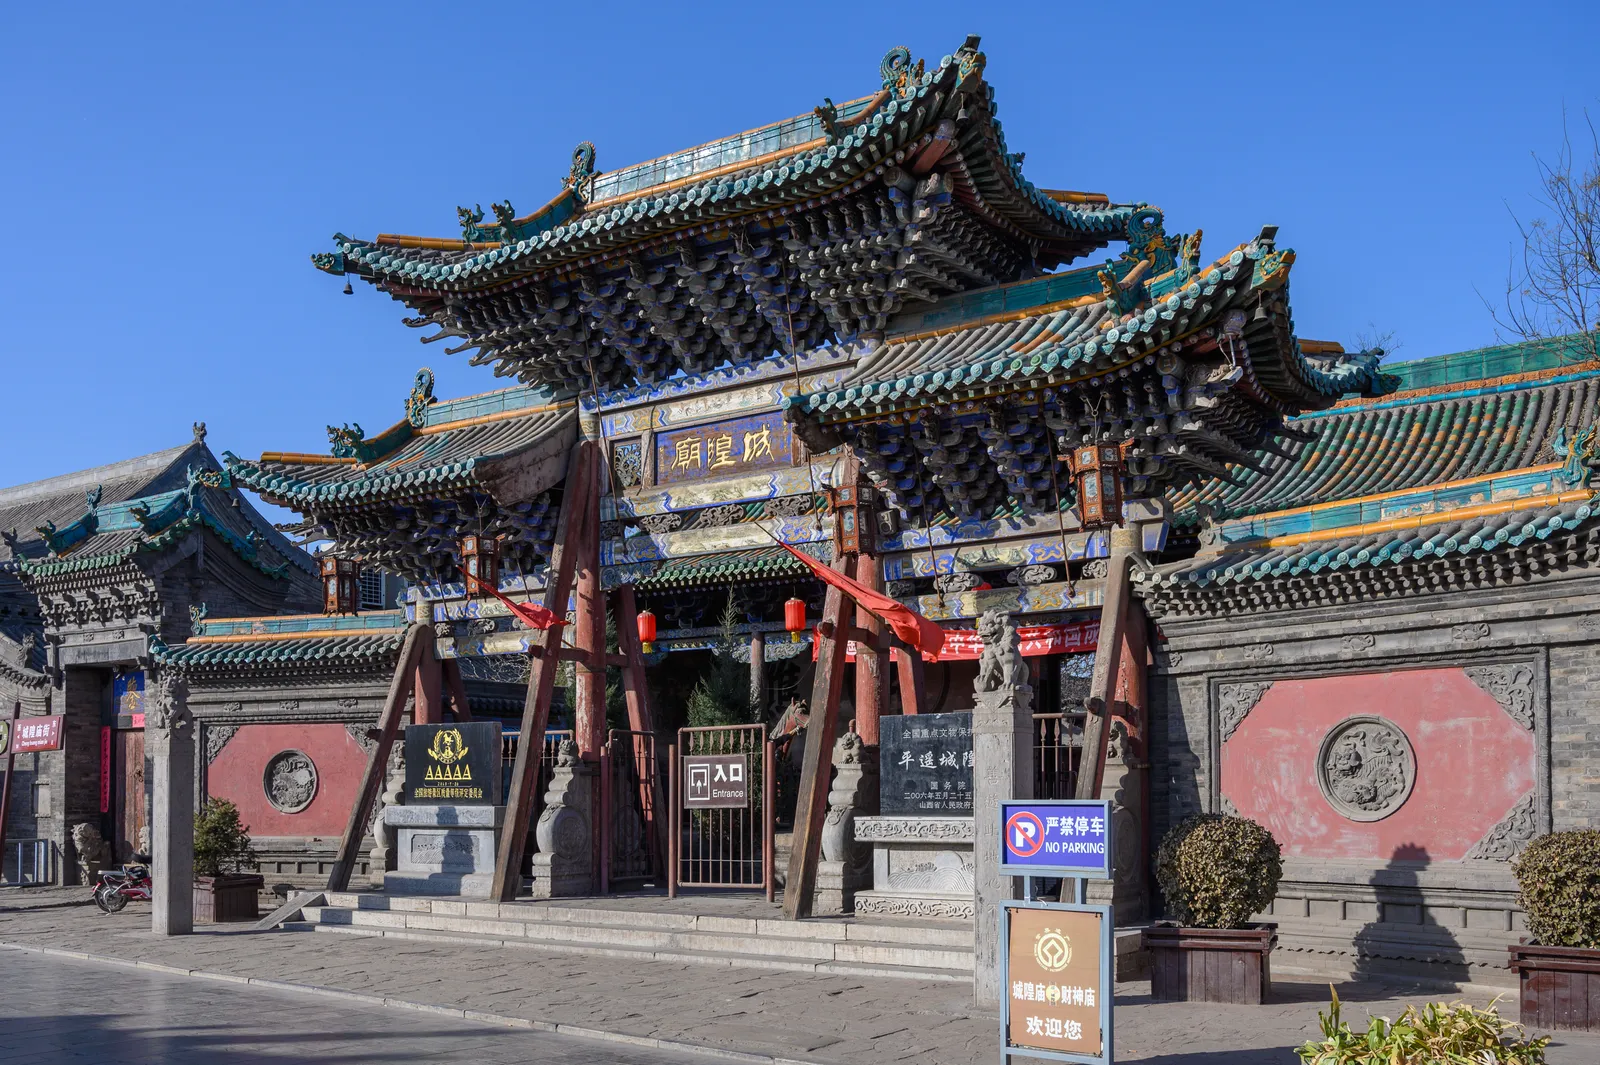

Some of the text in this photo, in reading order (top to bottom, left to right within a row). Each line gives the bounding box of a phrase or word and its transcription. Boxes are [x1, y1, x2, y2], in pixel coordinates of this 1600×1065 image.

[424, 764, 472, 780] AAAAA
[713, 763, 743, 783] 入口
[712, 789, 744, 798] Entrance
[930, 781, 966, 790] 国务院
[919, 801, 974, 809] 山西省人民政府
[1045, 816, 1104, 837] 严禁停车
[1045, 842, 1105, 854] NO PARKING
[1012, 980, 1046, 1002] 城隍庙
[1061, 985, 1095, 1007] 财神庙
[1026, 1015, 1083, 1041] 欢迎您
